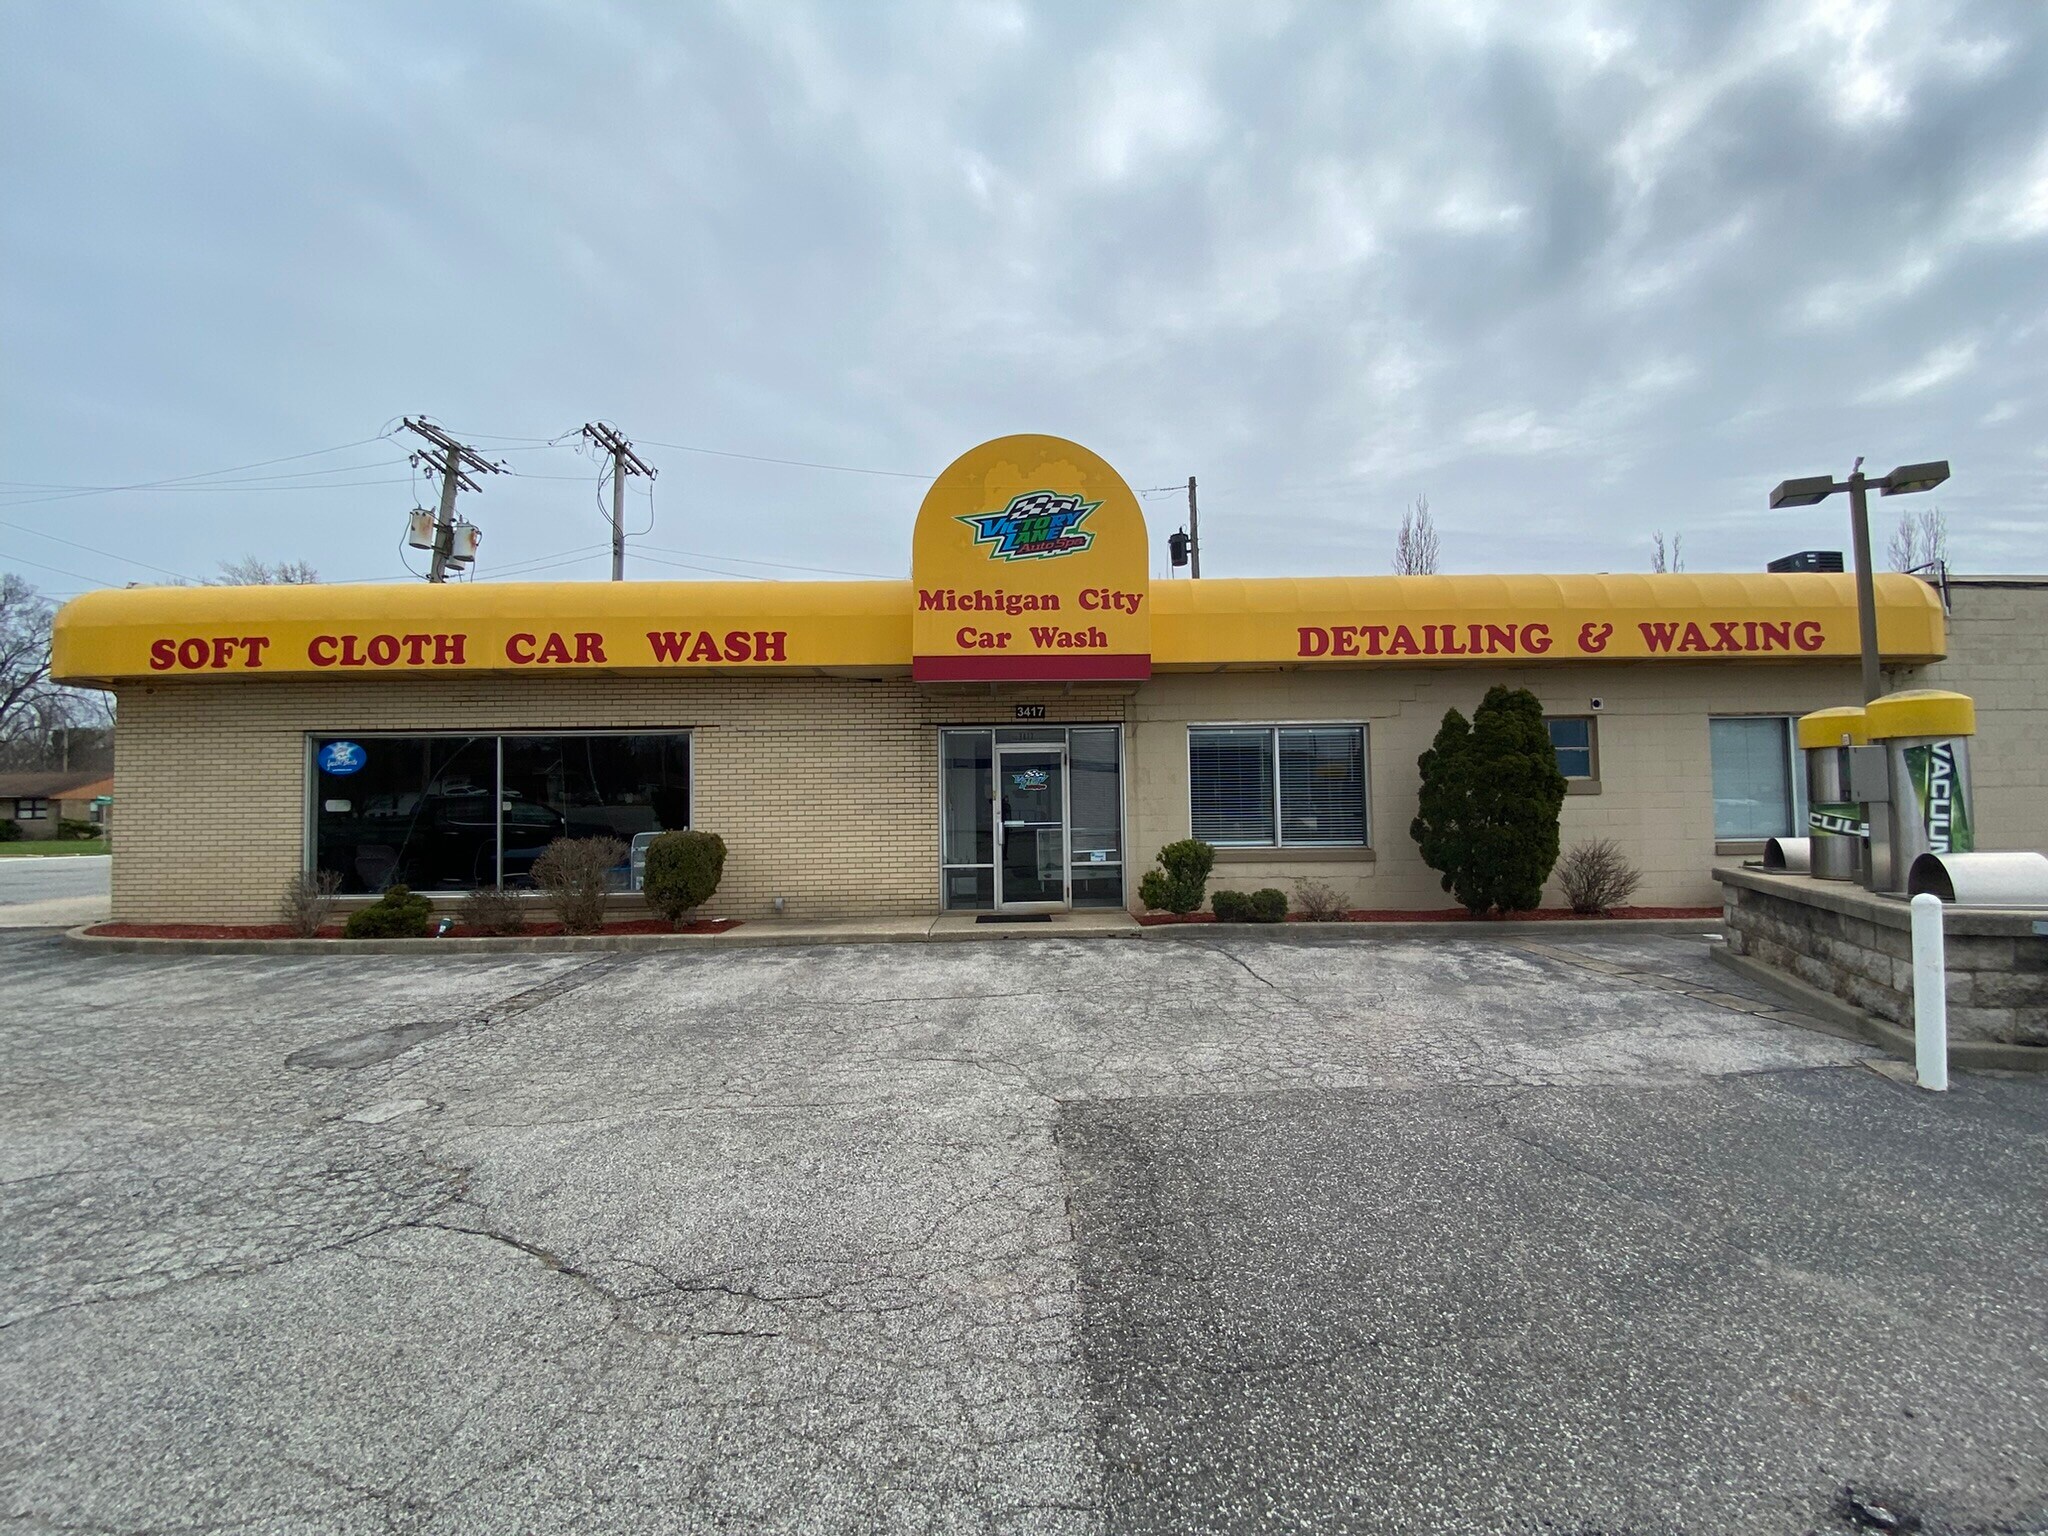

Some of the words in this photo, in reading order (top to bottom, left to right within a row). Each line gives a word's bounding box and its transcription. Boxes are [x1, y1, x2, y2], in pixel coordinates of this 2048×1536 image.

[981, 512, 1081, 536] VICTORY
[1002, 527, 1062, 551] LANE
[1018, 541, 1055, 554] Auto
[1054, 538, 1085, 550] Spa
[918, 589, 1060, 616] Michigan
[1078, 588, 1143, 615] City
[956, 627, 1012, 649] Car
[1029, 626, 1108, 649] Wash
[1297, 623, 1553, 657] DETAILING
[1577, 622, 1613, 653] &
[1637, 621, 1826, 653] WAXING
[150, 636, 270, 671] SOFT
[307, 634, 467, 667] CLOTH
[505, 632, 608, 664] CAR
[646, 631, 788, 662] WASH
[1017, 706, 1045, 717] 3417
